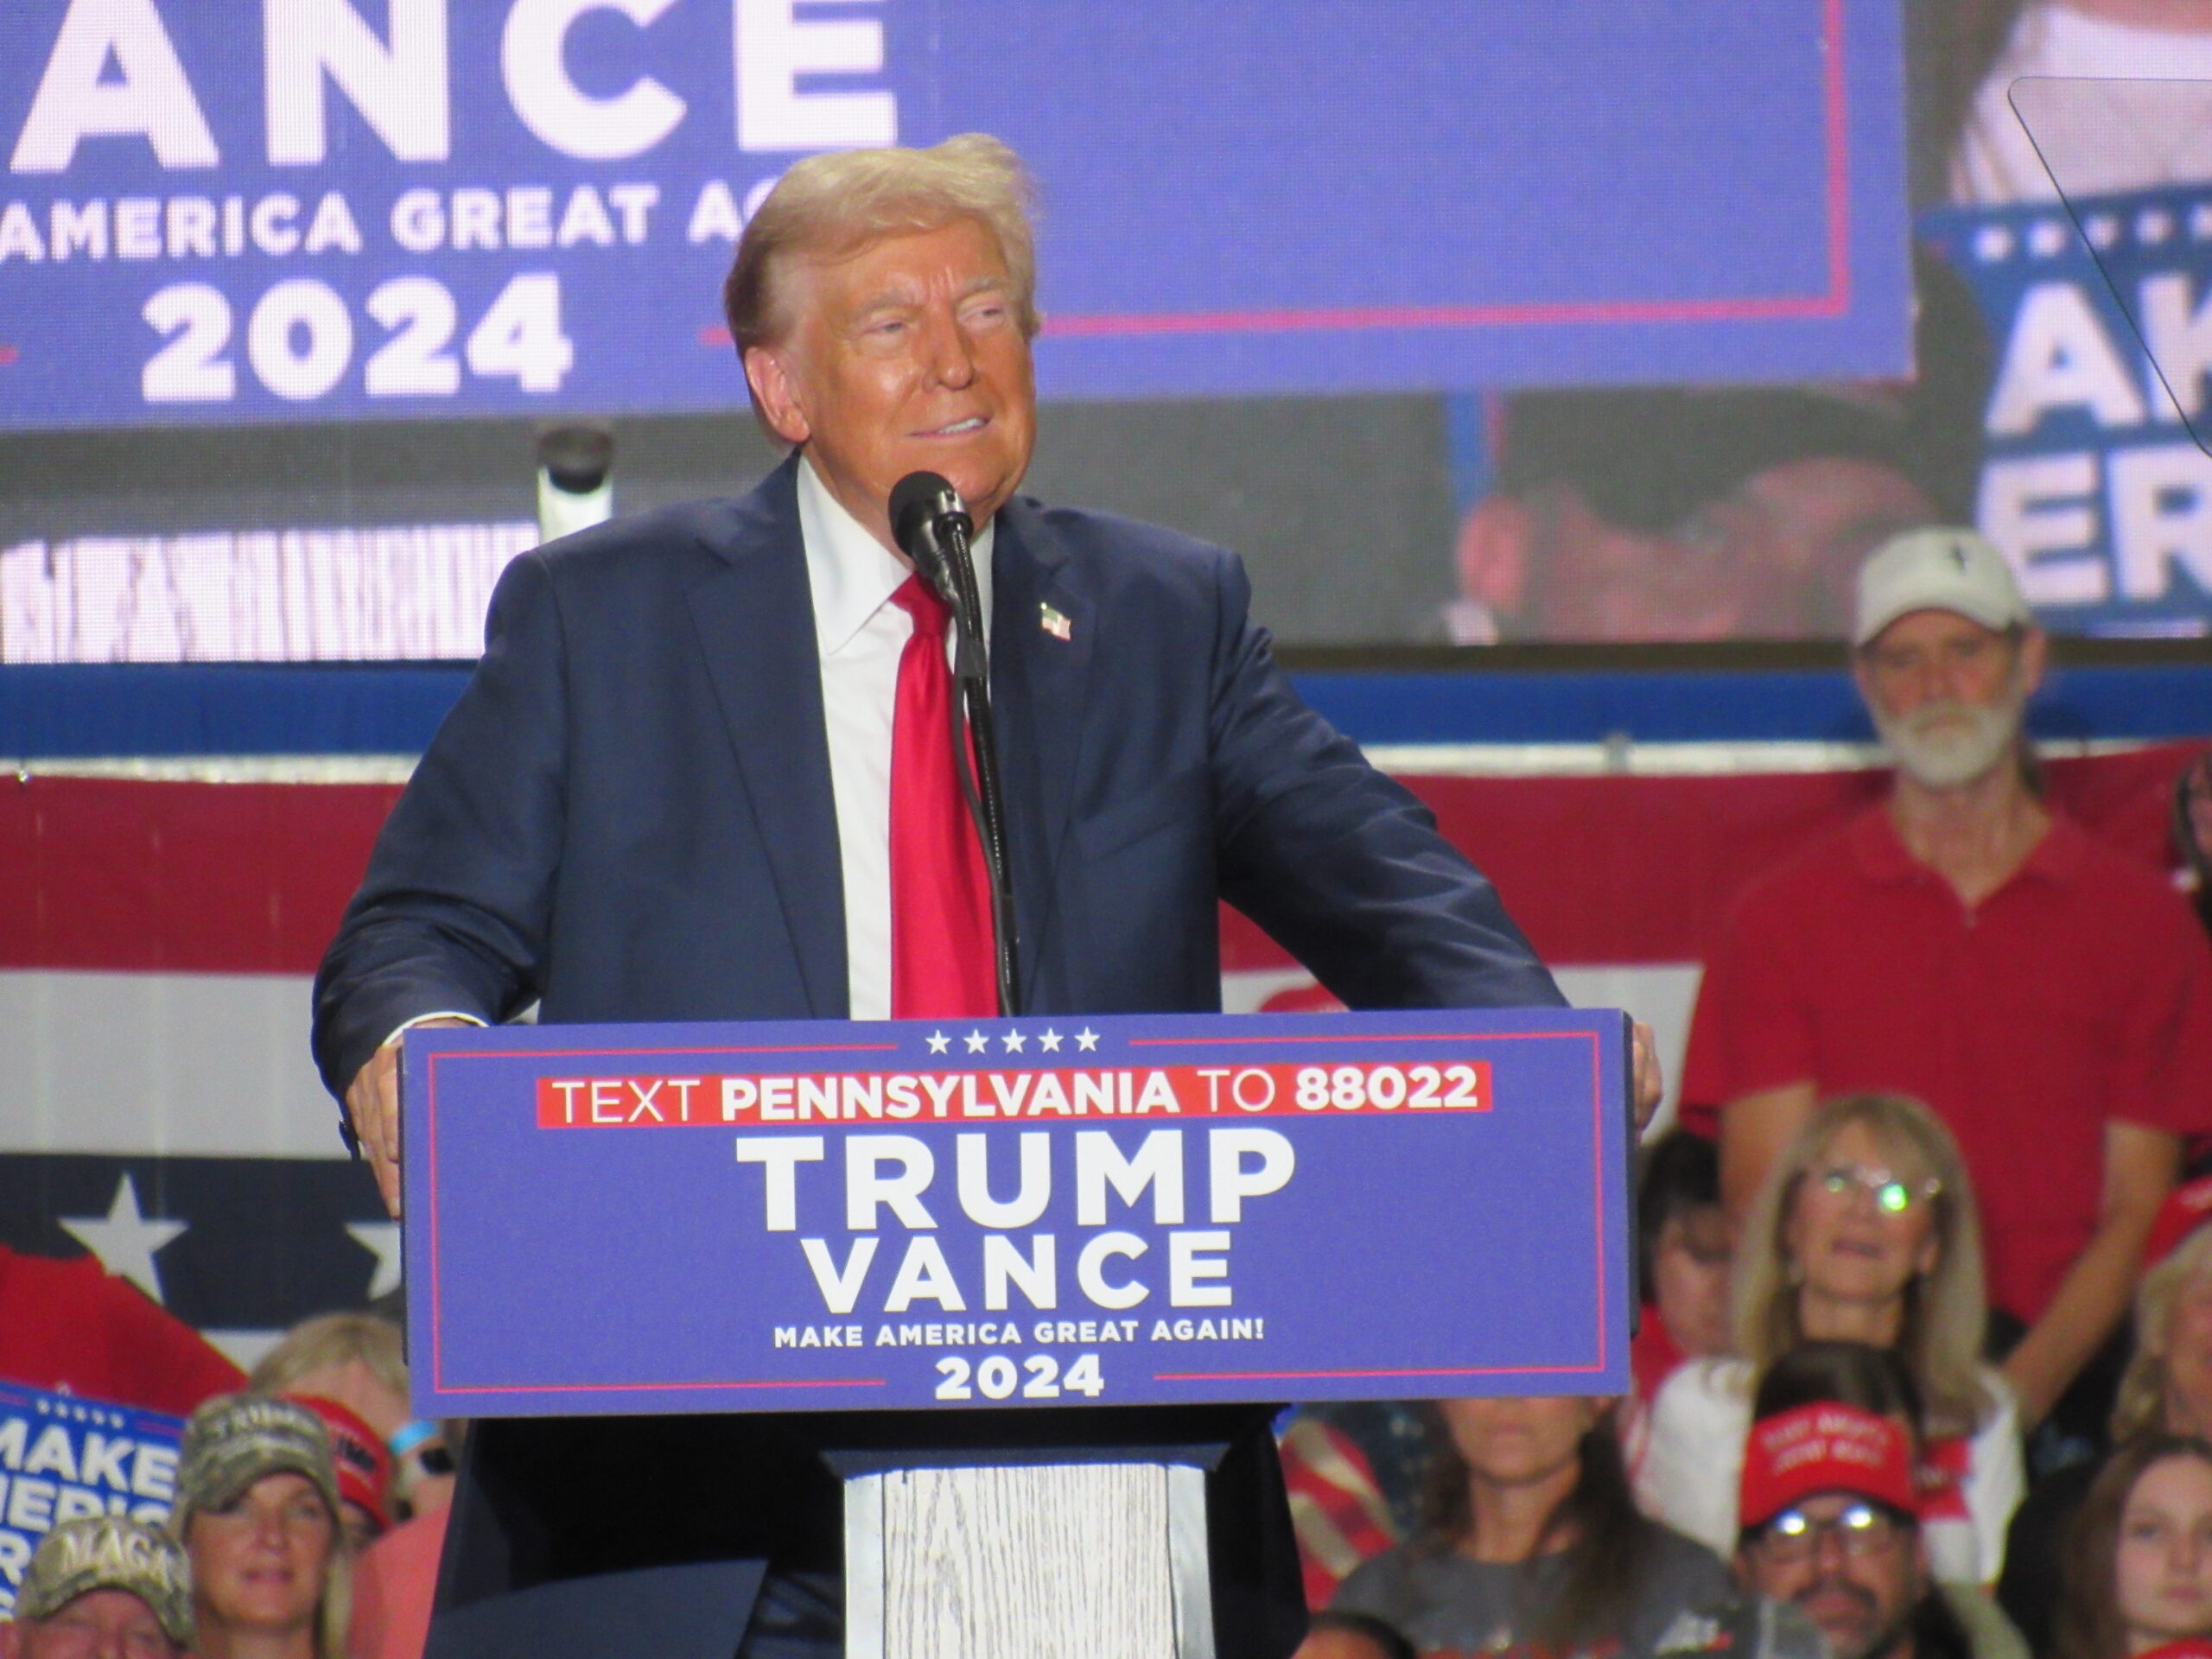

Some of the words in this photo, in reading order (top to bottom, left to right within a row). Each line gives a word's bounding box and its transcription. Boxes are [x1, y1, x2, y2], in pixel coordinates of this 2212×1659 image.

[0, 190, 361, 262] AMERICA
[390, 182, 660, 251] GREAT
[141, 272, 575, 402] 2024
[551, 1079, 701, 1123] TEXT
[721, 1070, 1181, 1122] PENNSYLVANIA
[1196, 1068, 1276, 1113] TO
[1295, 1065, 1478, 1111] 88022
[735, 1127, 1295, 1232] TRUMP
[799, 1230, 1233, 1315] VANCE
[773, 1325, 863, 1349] MAKE
[875, 1322, 1023, 1348] AMERICA
[1033, 1319, 1140, 1344] GREAT
[1150, 1317, 1265, 1342] AGAIN!
[934, 1353, 1105, 1401] 2024
